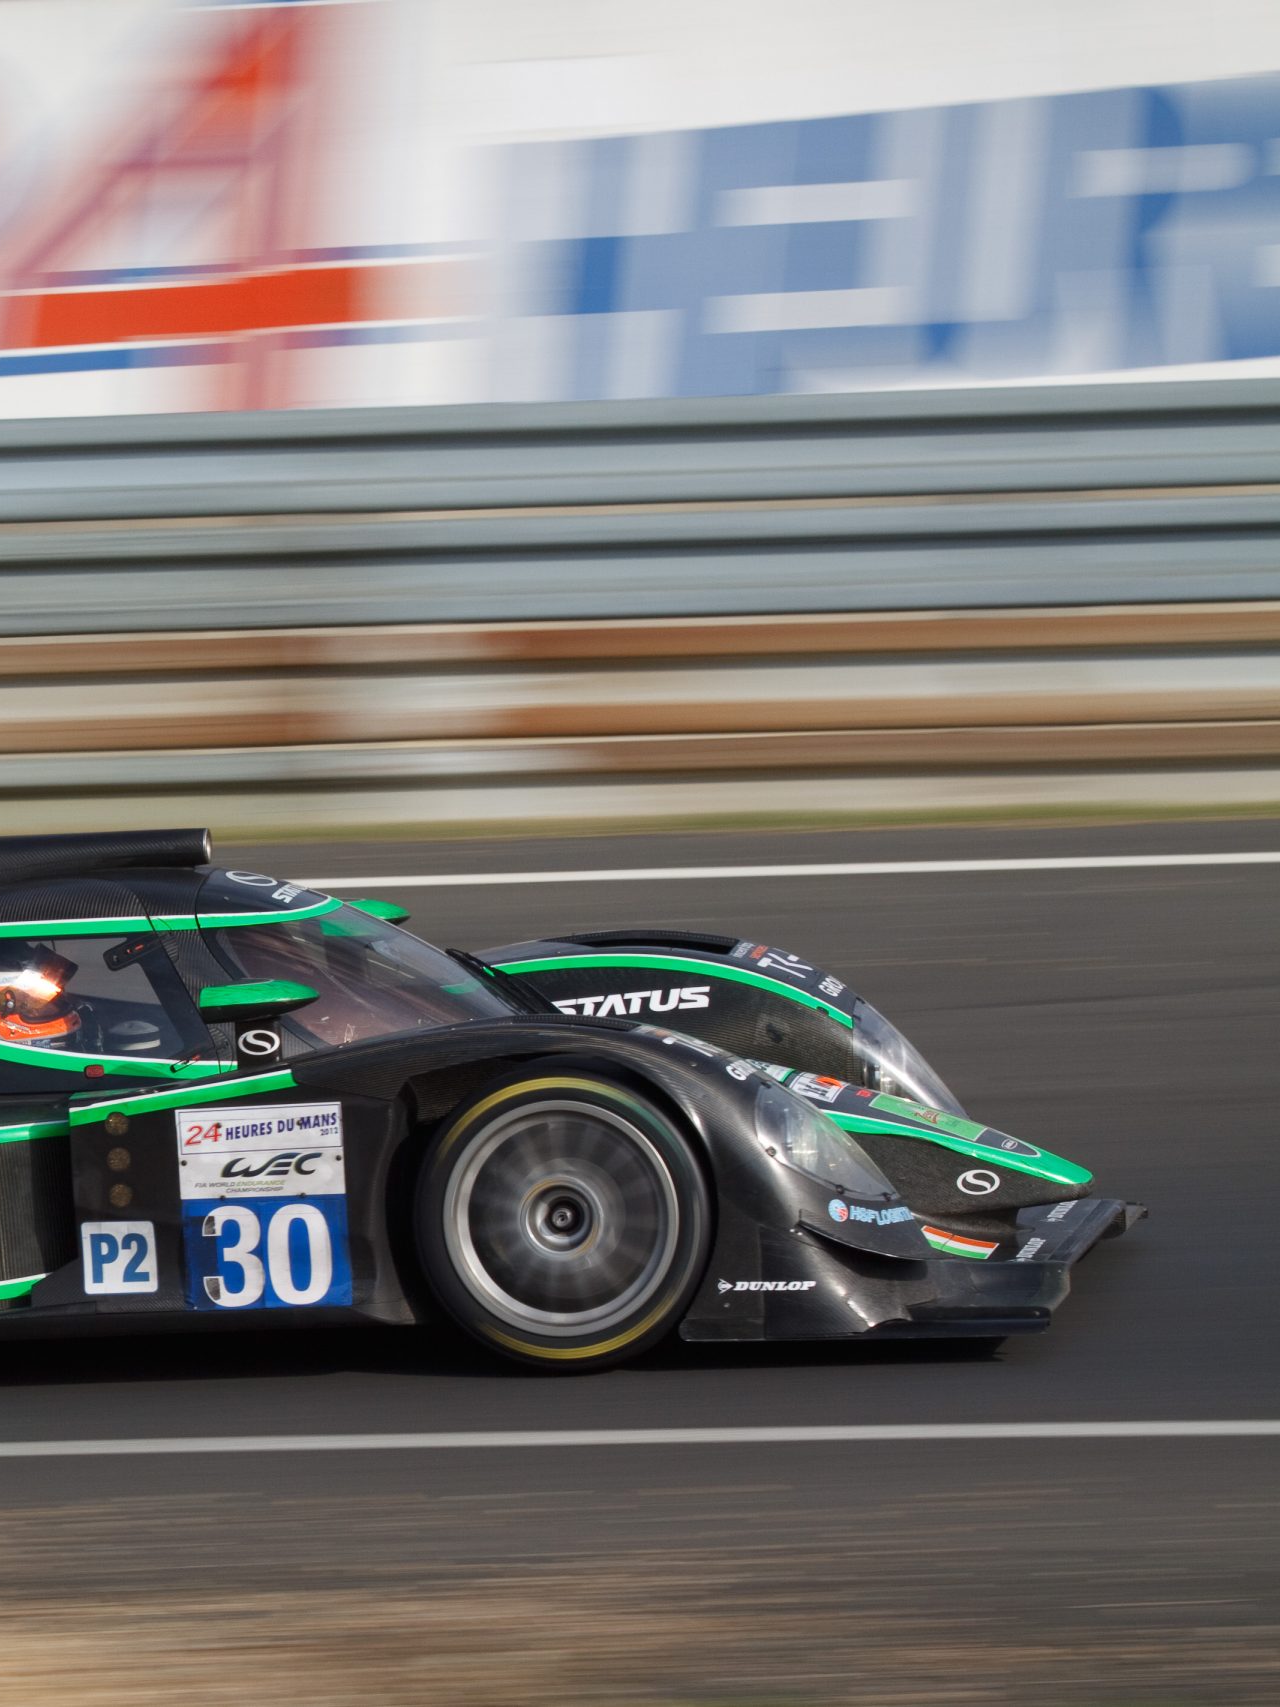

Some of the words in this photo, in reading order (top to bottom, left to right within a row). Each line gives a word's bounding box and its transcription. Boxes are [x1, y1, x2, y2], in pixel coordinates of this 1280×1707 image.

[551, 985, 711, 1017] STATUS
[184, 1123, 222, 1146] 24
[225, 1123, 273, 1140] HEURES
[277, 1118, 295, 1133] DU
[299, 1112, 337, 1130] MANS
[320, 1127, 339, 1136] 2012
[221, 1152, 323, 1178] WEC
[89, 1232, 151, 1284] P2
[202, 1203, 333, 1308] 30
[733, 1280, 817, 1291] DUNLOP
